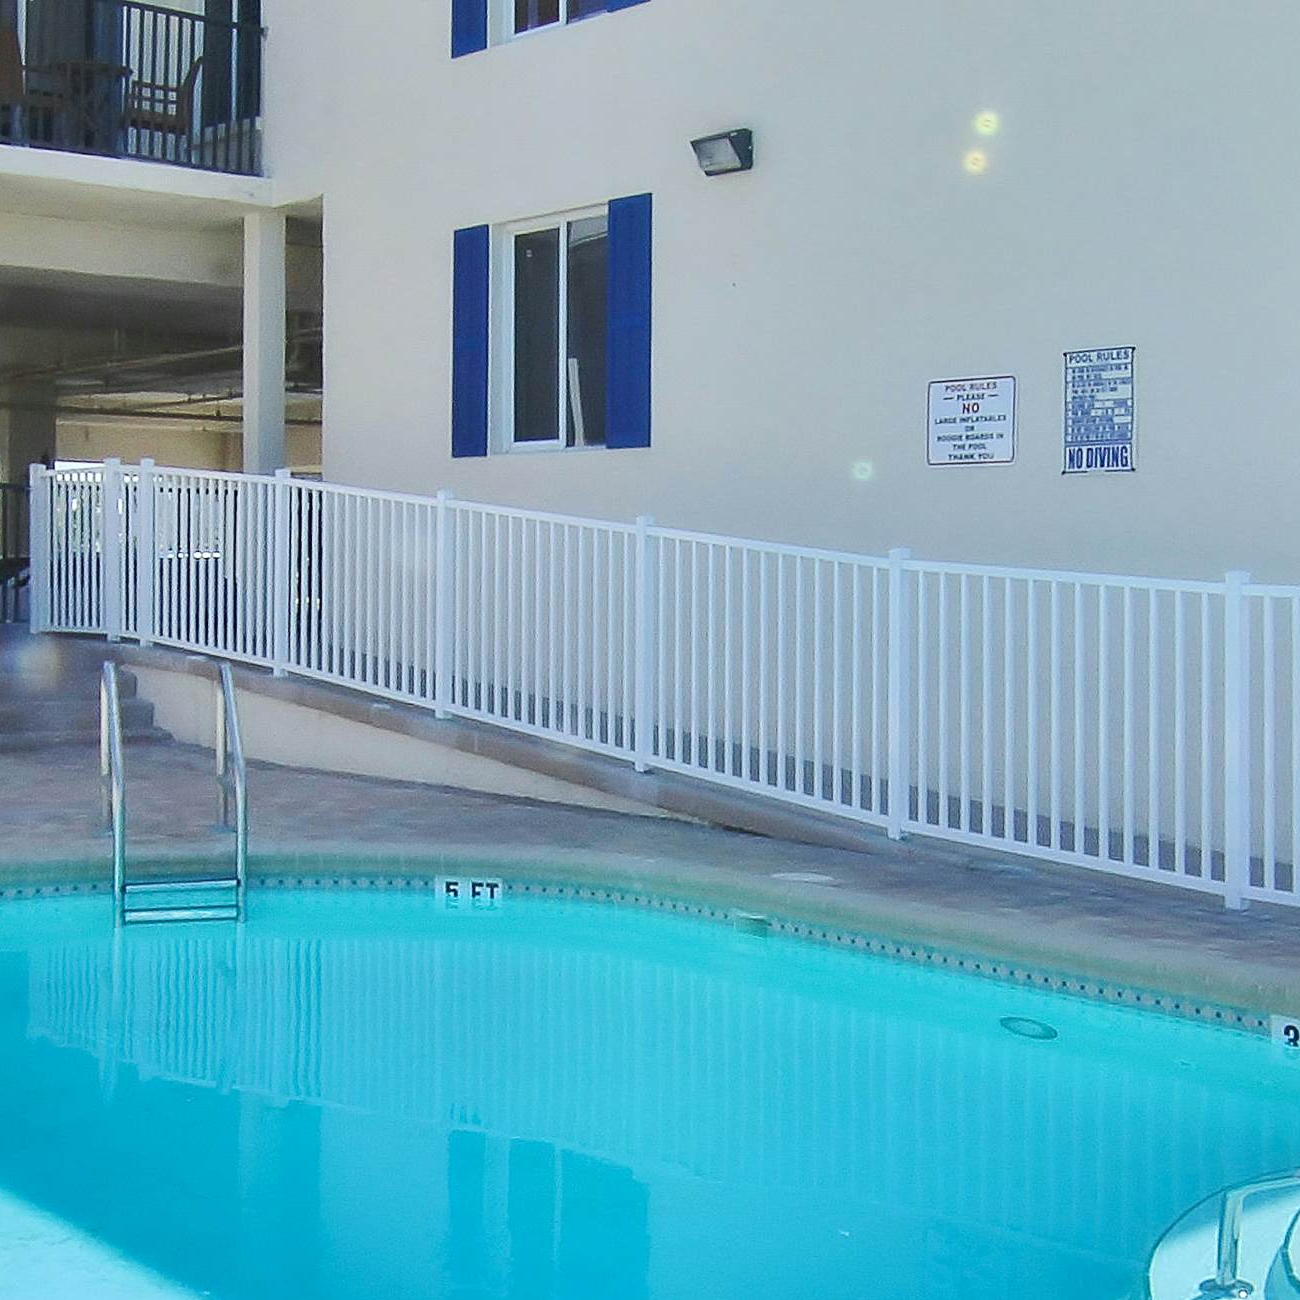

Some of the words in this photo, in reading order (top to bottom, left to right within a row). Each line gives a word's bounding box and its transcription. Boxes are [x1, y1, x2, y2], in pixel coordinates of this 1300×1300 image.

[1069, 353, 1093, 364] POOL
[1096, 350, 1130, 362] RULES
[944, 384, 967, 392] POOL
[969, 381, 997, 391] RULES
[956, 393, 986, 401] PLEASE
[962, 402, 980, 414] NO
[1067, 447, 1083, 469] NO
[1086, 445, 1129, 469] DIVING
[445, 881, 459, 898] 5
[471, 881, 499, 900] FT
